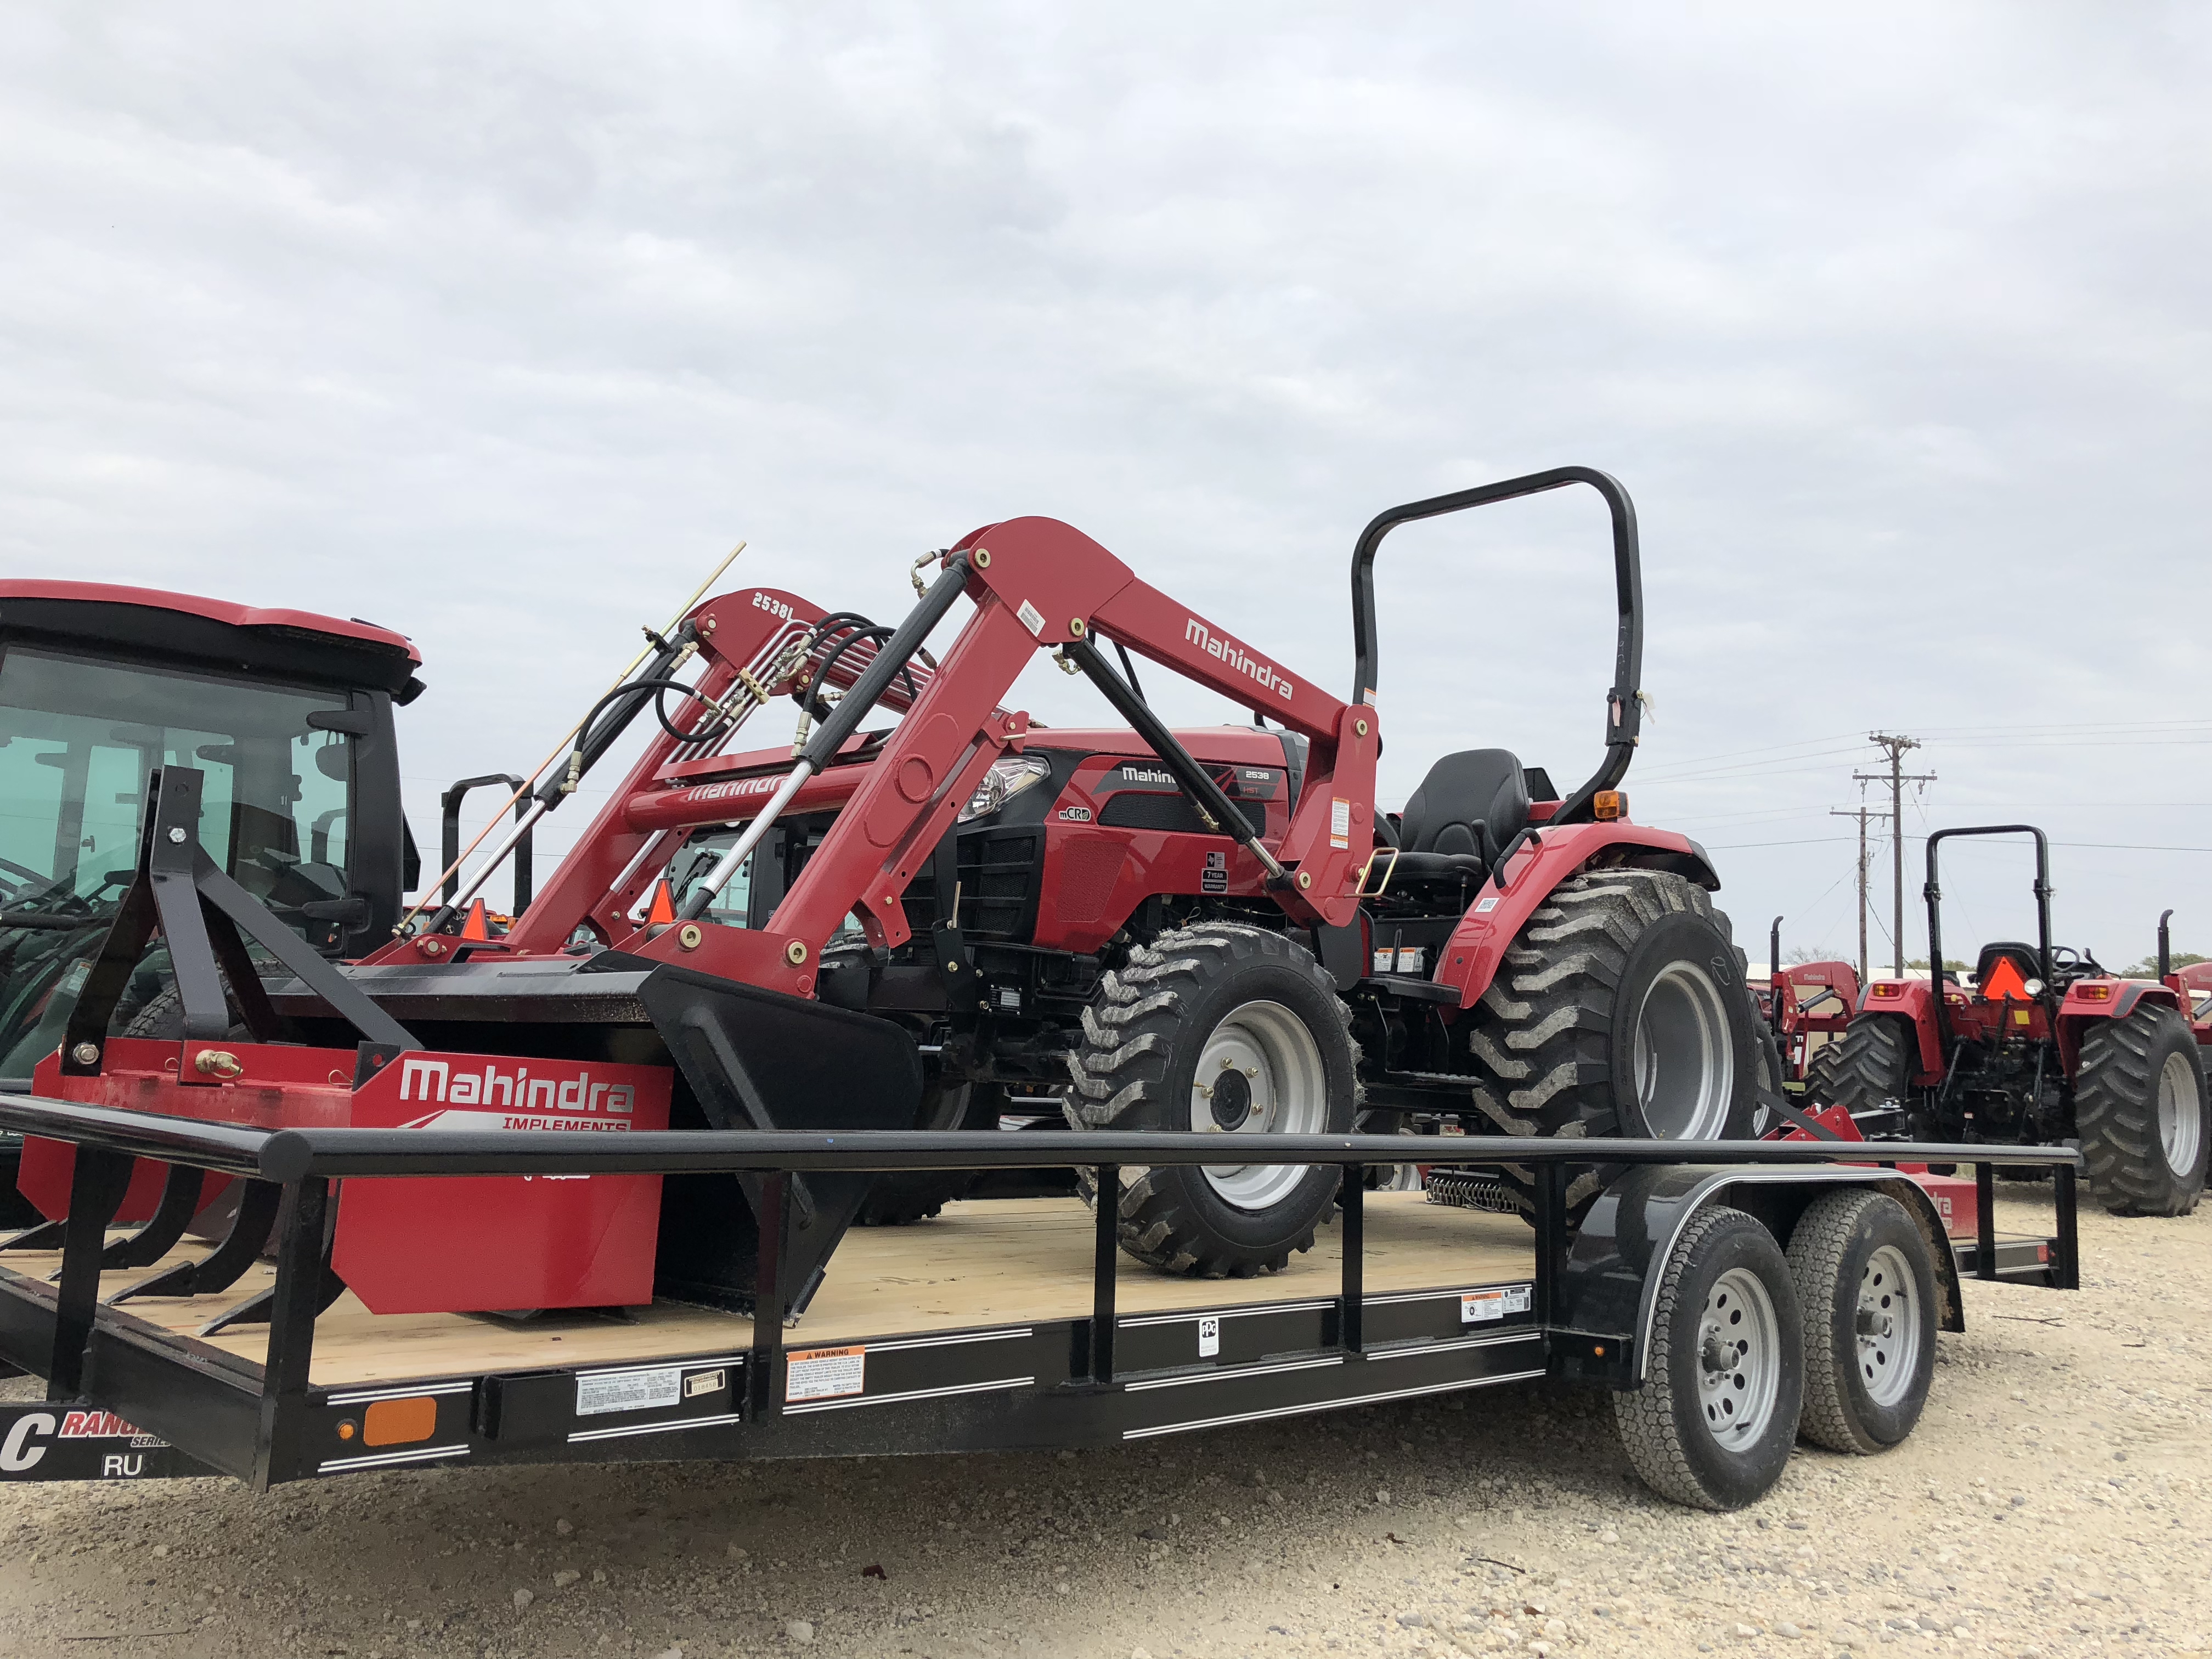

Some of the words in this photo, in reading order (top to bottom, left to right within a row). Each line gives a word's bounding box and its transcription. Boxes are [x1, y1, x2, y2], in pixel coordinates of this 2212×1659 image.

[752, 591, 794, 622] 2538L
[1185, 618, 1293, 701] Mahindra
[1122, 767, 1176, 784] Mahin
[1245, 771, 1269, 780] 2538
[400, 1059, 635, 1113] Mahindra
[502, 1117, 627, 1131] IMPLEMENTS
[815, 1349, 849, 1358] WARNING
[0, 1413, 55, 1471] C
[104, 1455, 143, 1476] RU
